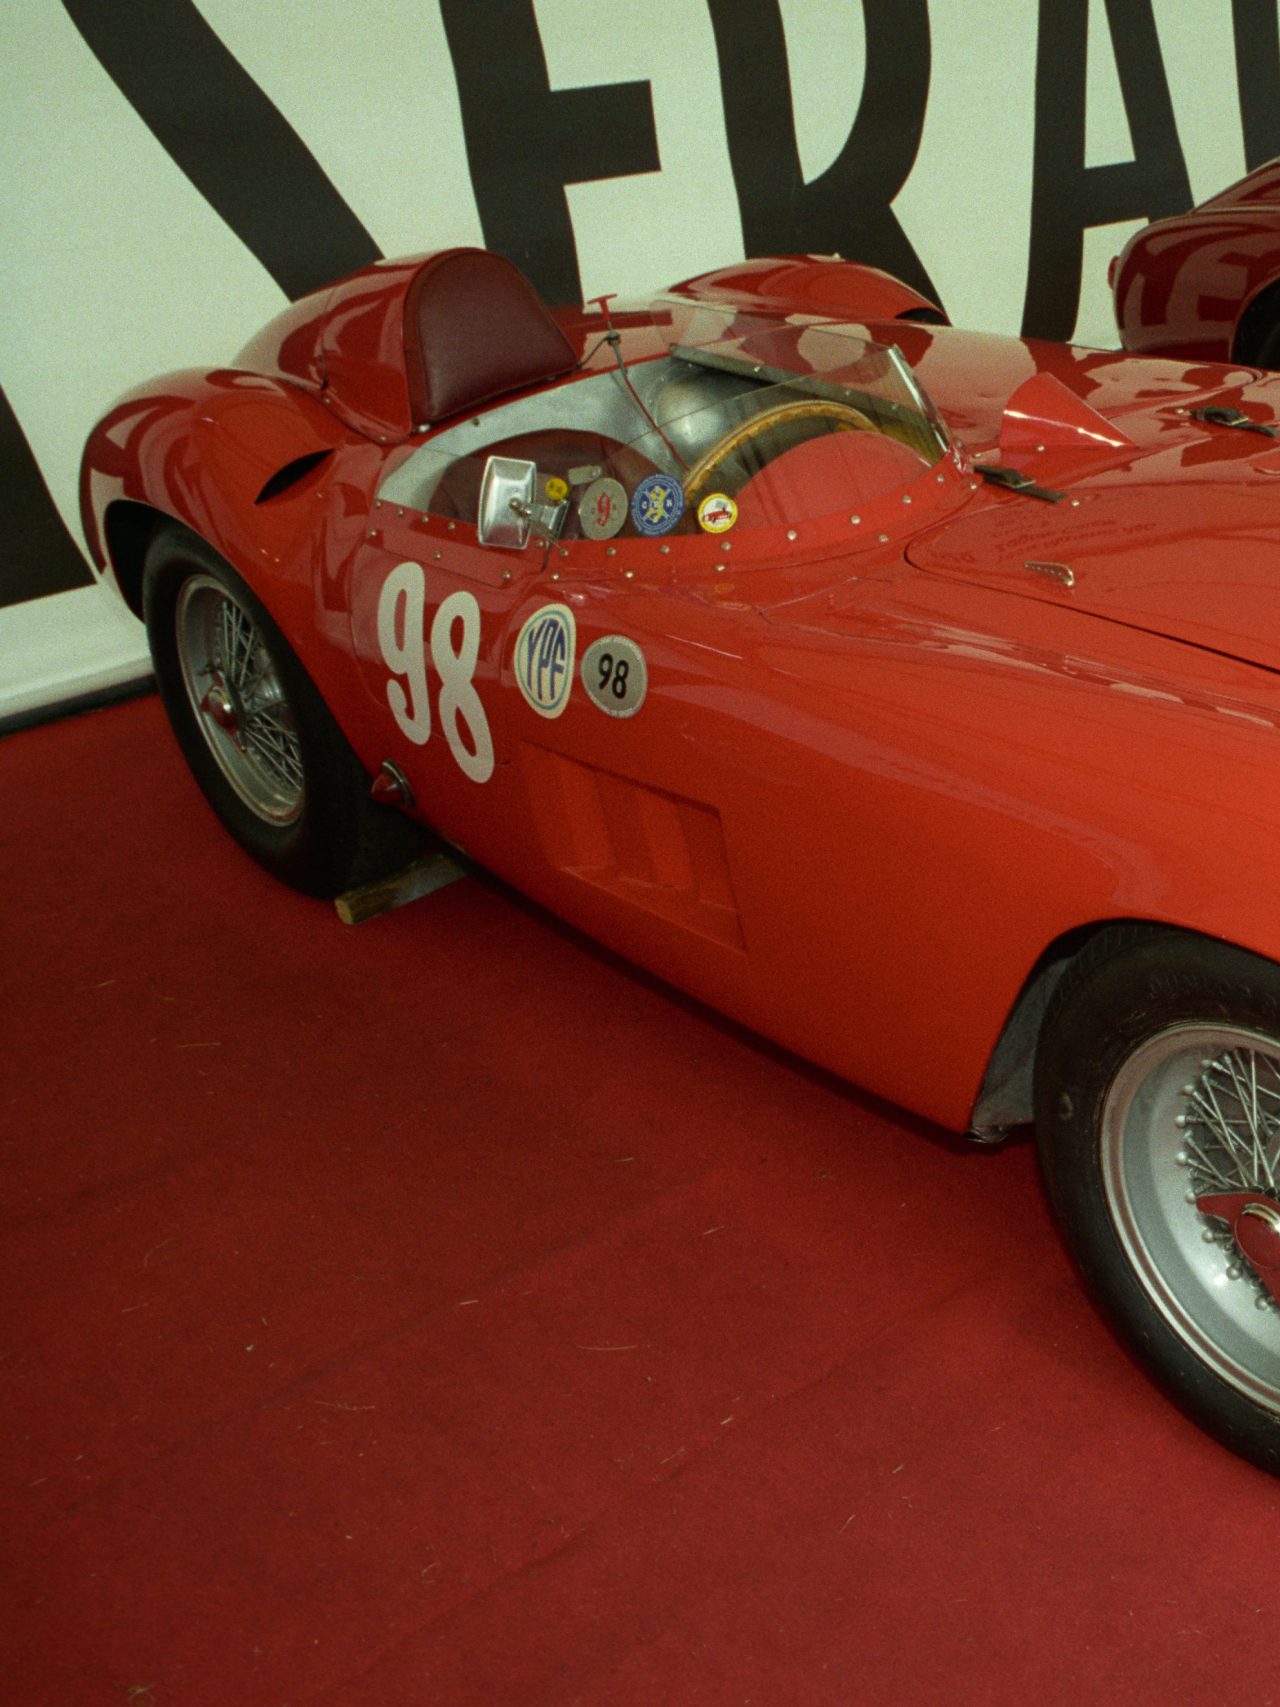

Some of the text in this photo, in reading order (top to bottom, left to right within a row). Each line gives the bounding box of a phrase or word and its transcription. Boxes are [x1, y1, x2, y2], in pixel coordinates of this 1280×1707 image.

[377, 561, 495, 784] 98
[527, 618, 566, 700] YPF
[598, 653, 629, 699] 98
